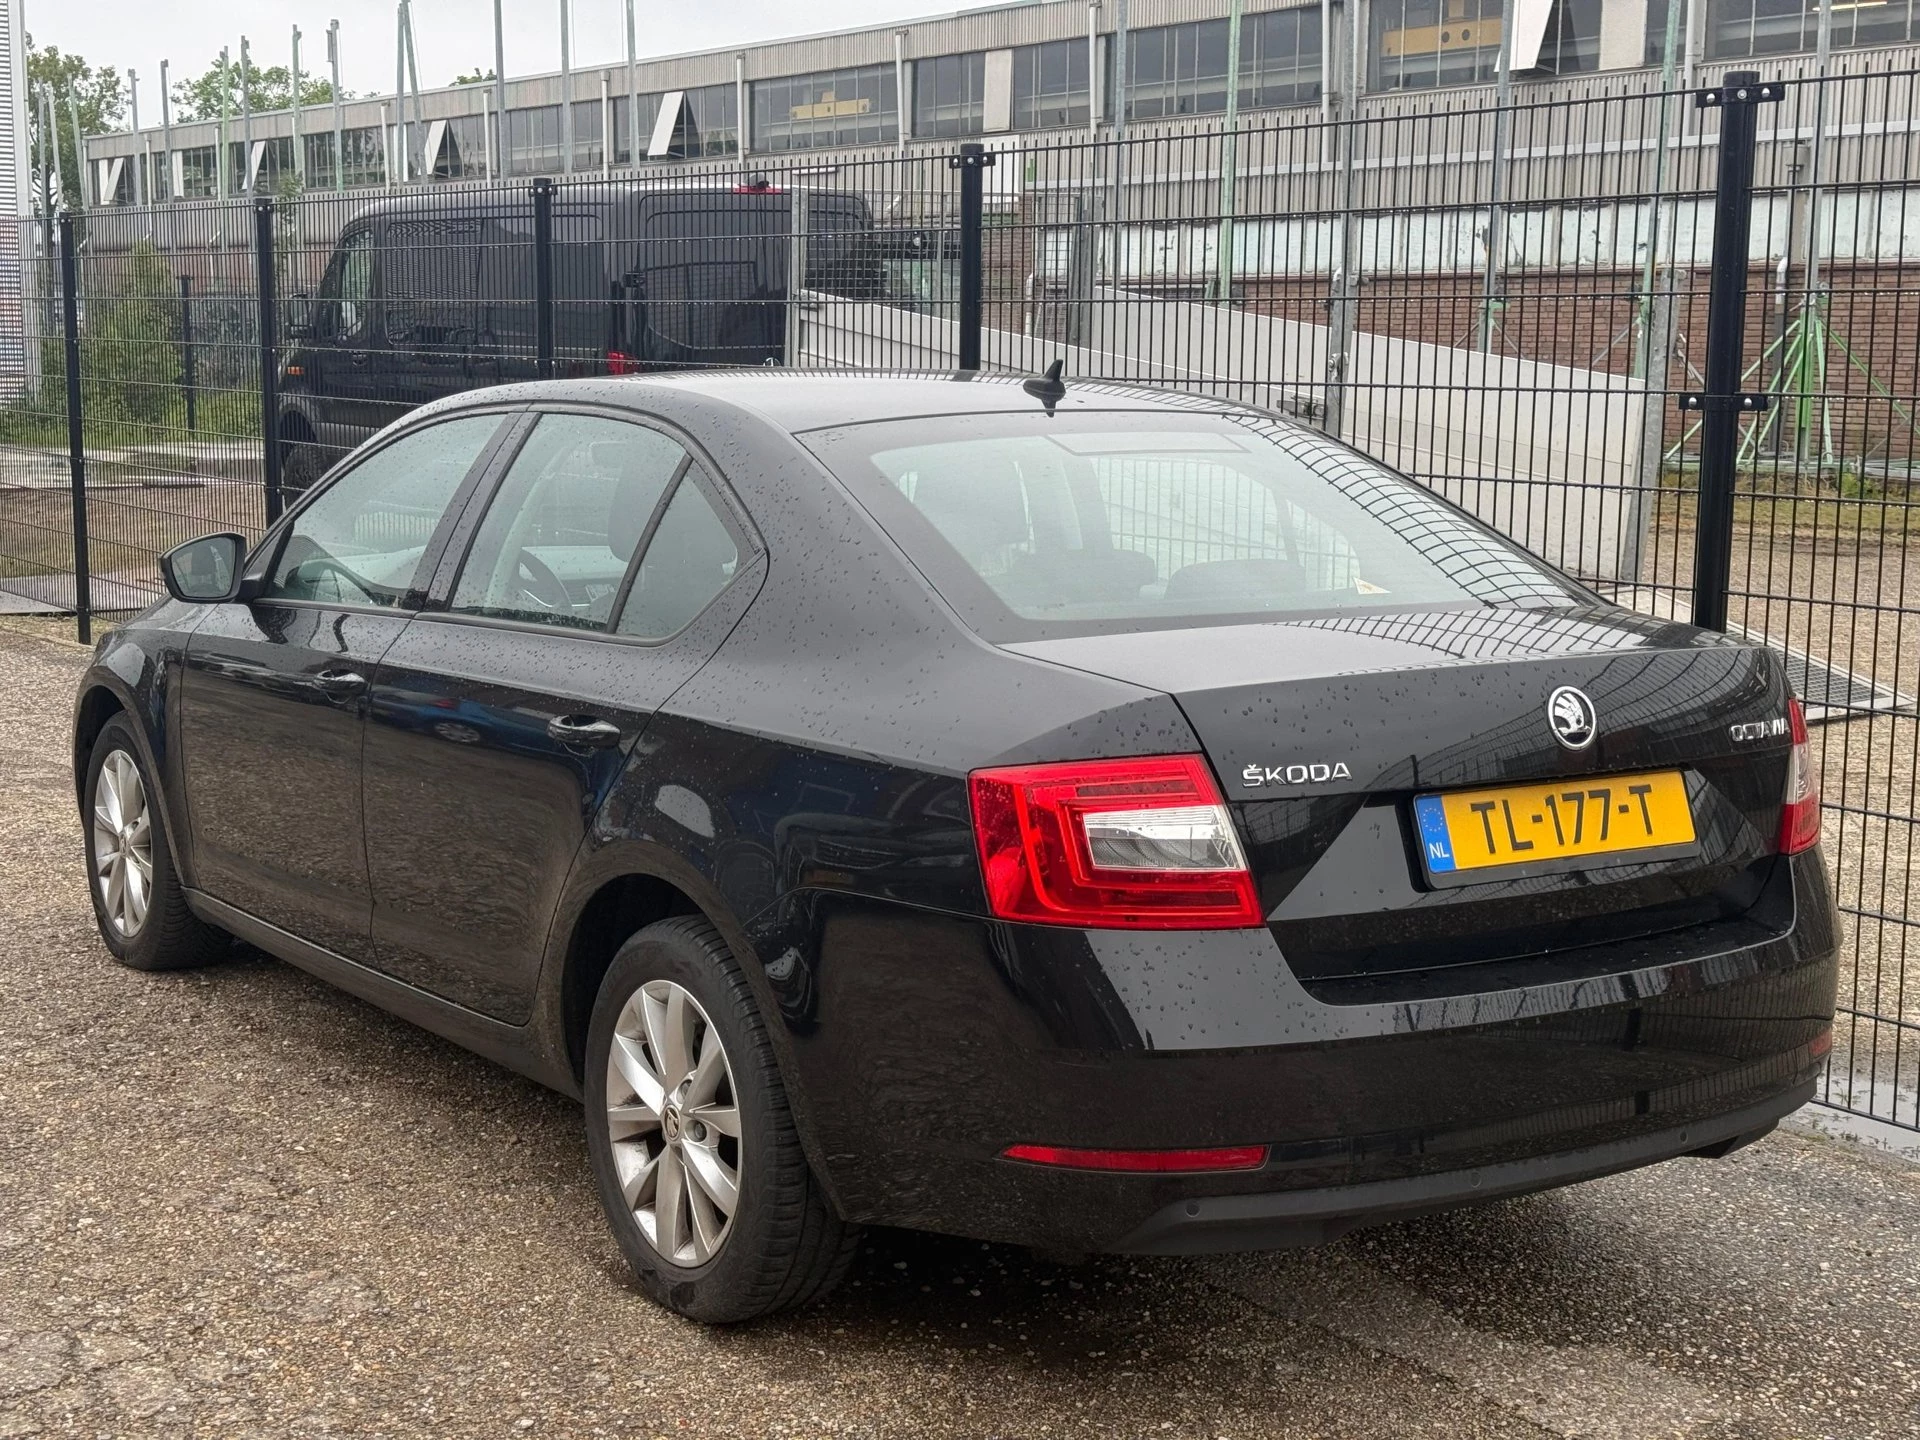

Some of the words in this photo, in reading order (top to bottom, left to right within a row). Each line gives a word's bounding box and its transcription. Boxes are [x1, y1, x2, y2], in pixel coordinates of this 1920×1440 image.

[1242, 762, 1353, 787] ŠKODA
[1470, 784, 1653, 854] TL-177-T
[1428, 842, 1450, 859] NL
